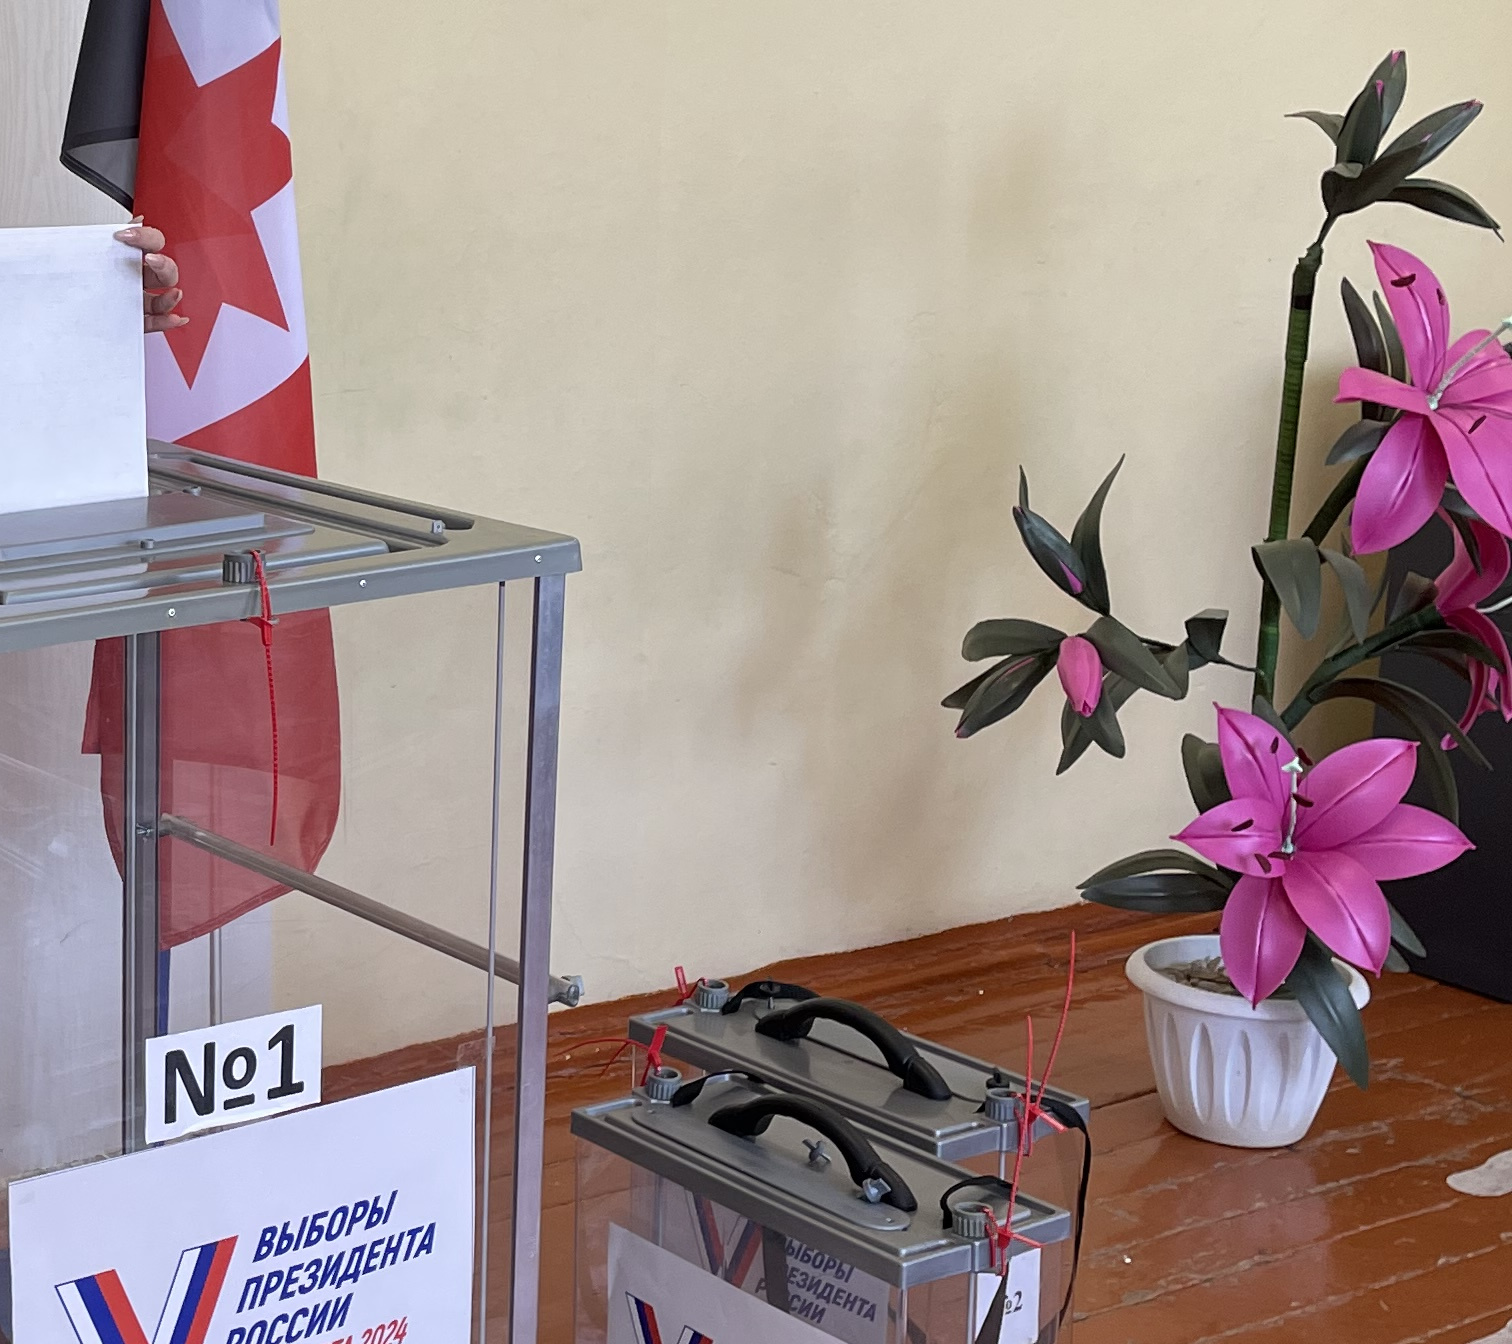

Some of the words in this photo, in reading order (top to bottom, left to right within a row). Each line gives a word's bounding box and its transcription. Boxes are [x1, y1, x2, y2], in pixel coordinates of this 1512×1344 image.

[165, 1023, 304, 1125] №1
[252, 1190, 399, 1263] ВЫБОРЫ
[236, 1222, 436, 1314] ПРЕЗИДЕНТА
[785, 1238, 855, 1283] ЫБОРЫ
[755, 1277, 826, 1324] РСИИ
[788, 1266, 877, 1322] ЕЗИДЕНТА
